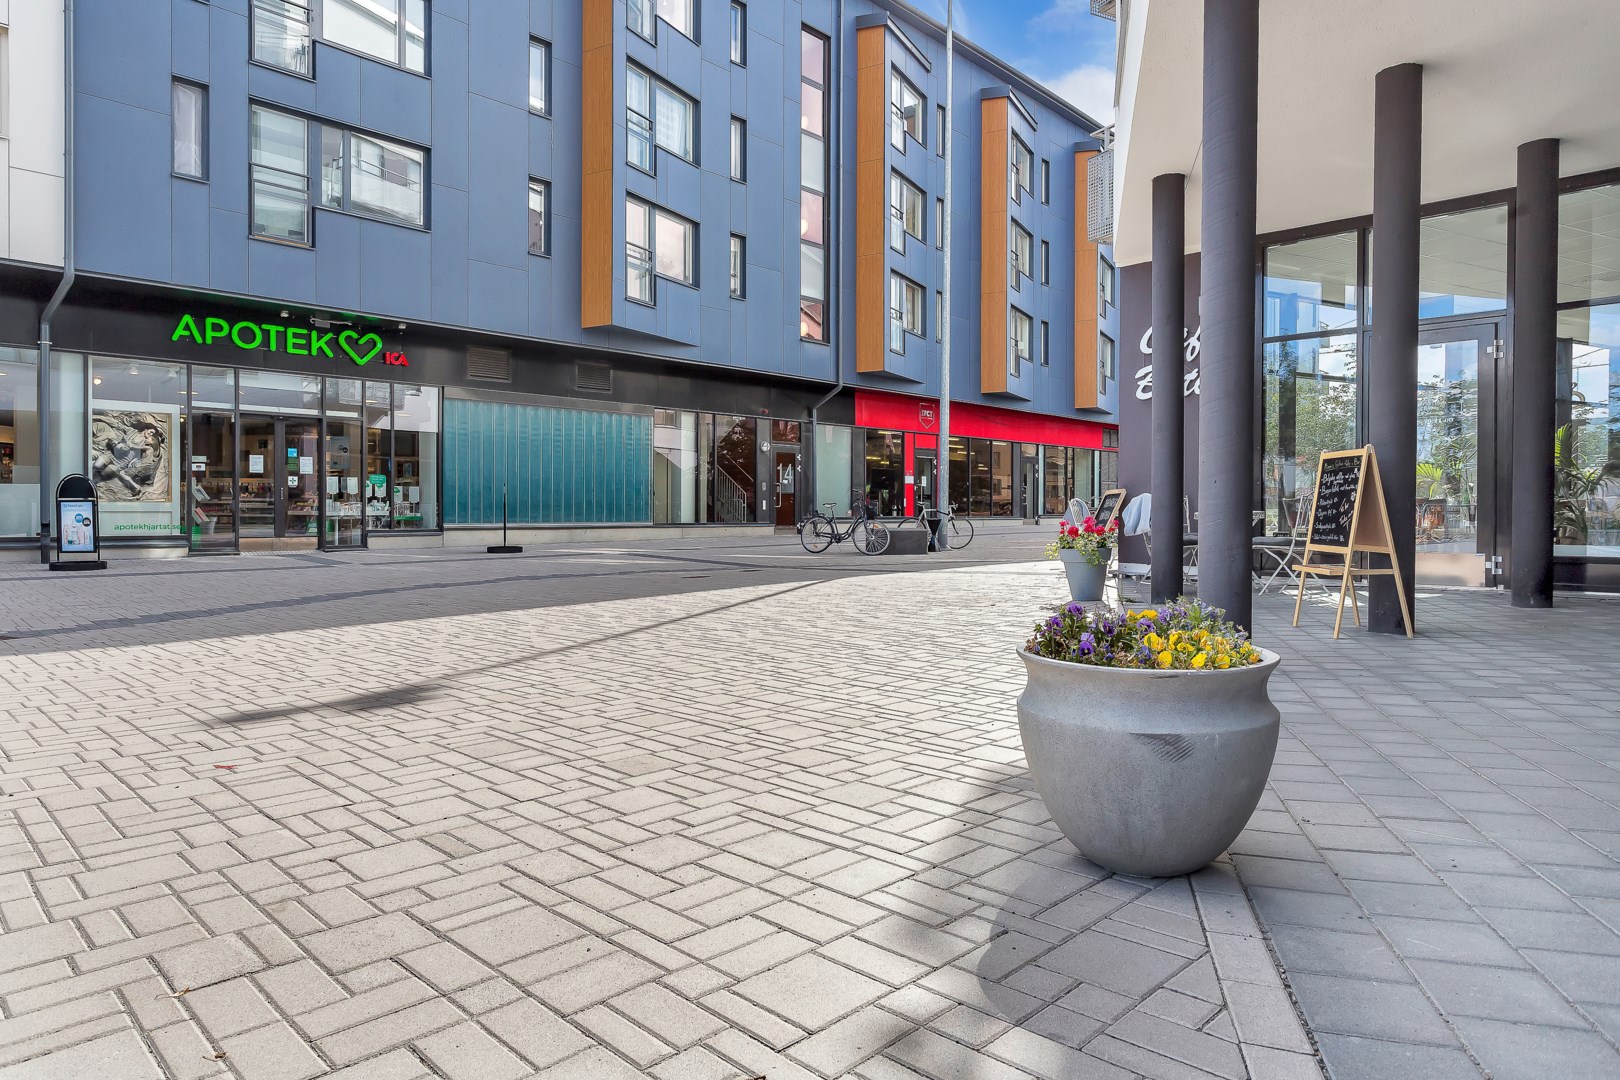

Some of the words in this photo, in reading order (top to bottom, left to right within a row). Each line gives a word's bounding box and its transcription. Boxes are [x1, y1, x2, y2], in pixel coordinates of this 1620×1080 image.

[171, 314, 334, 358] APOTEK
[385, 352, 409, 367] ICA
[776, 463, 793, 483] 14
